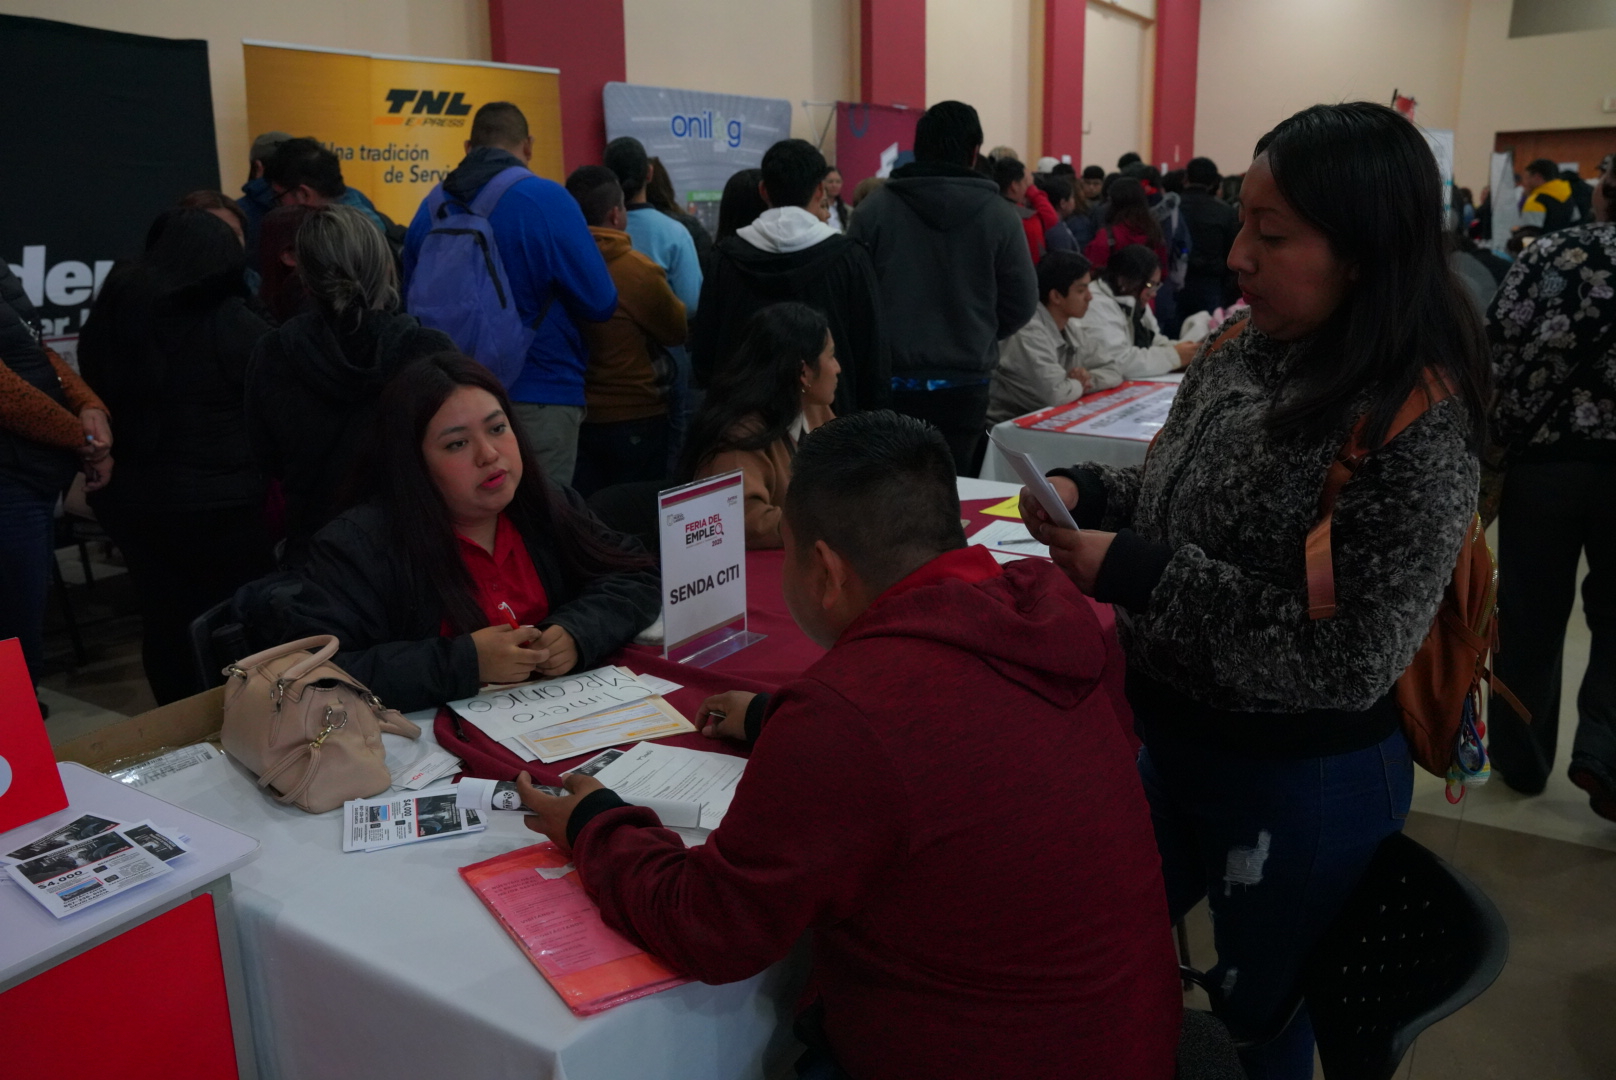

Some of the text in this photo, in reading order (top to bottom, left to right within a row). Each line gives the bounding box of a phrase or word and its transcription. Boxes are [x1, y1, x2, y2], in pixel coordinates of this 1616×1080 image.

[385, 89, 472, 115] TNL
[405, 117, 465, 128] EXPRESS
[360, 142, 429, 161] tradición
[384, 165, 404, 183] de
[685, 513, 722, 533] FERIA DEL
[685, 522, 724, 545] EMPLEO
[712, 538, 723, 547] 2025
[670, 564, 740, 605] SENDA CITI
[403, 799, 412, 817] $4,000
[37, 870, 83, 890] $4,000
